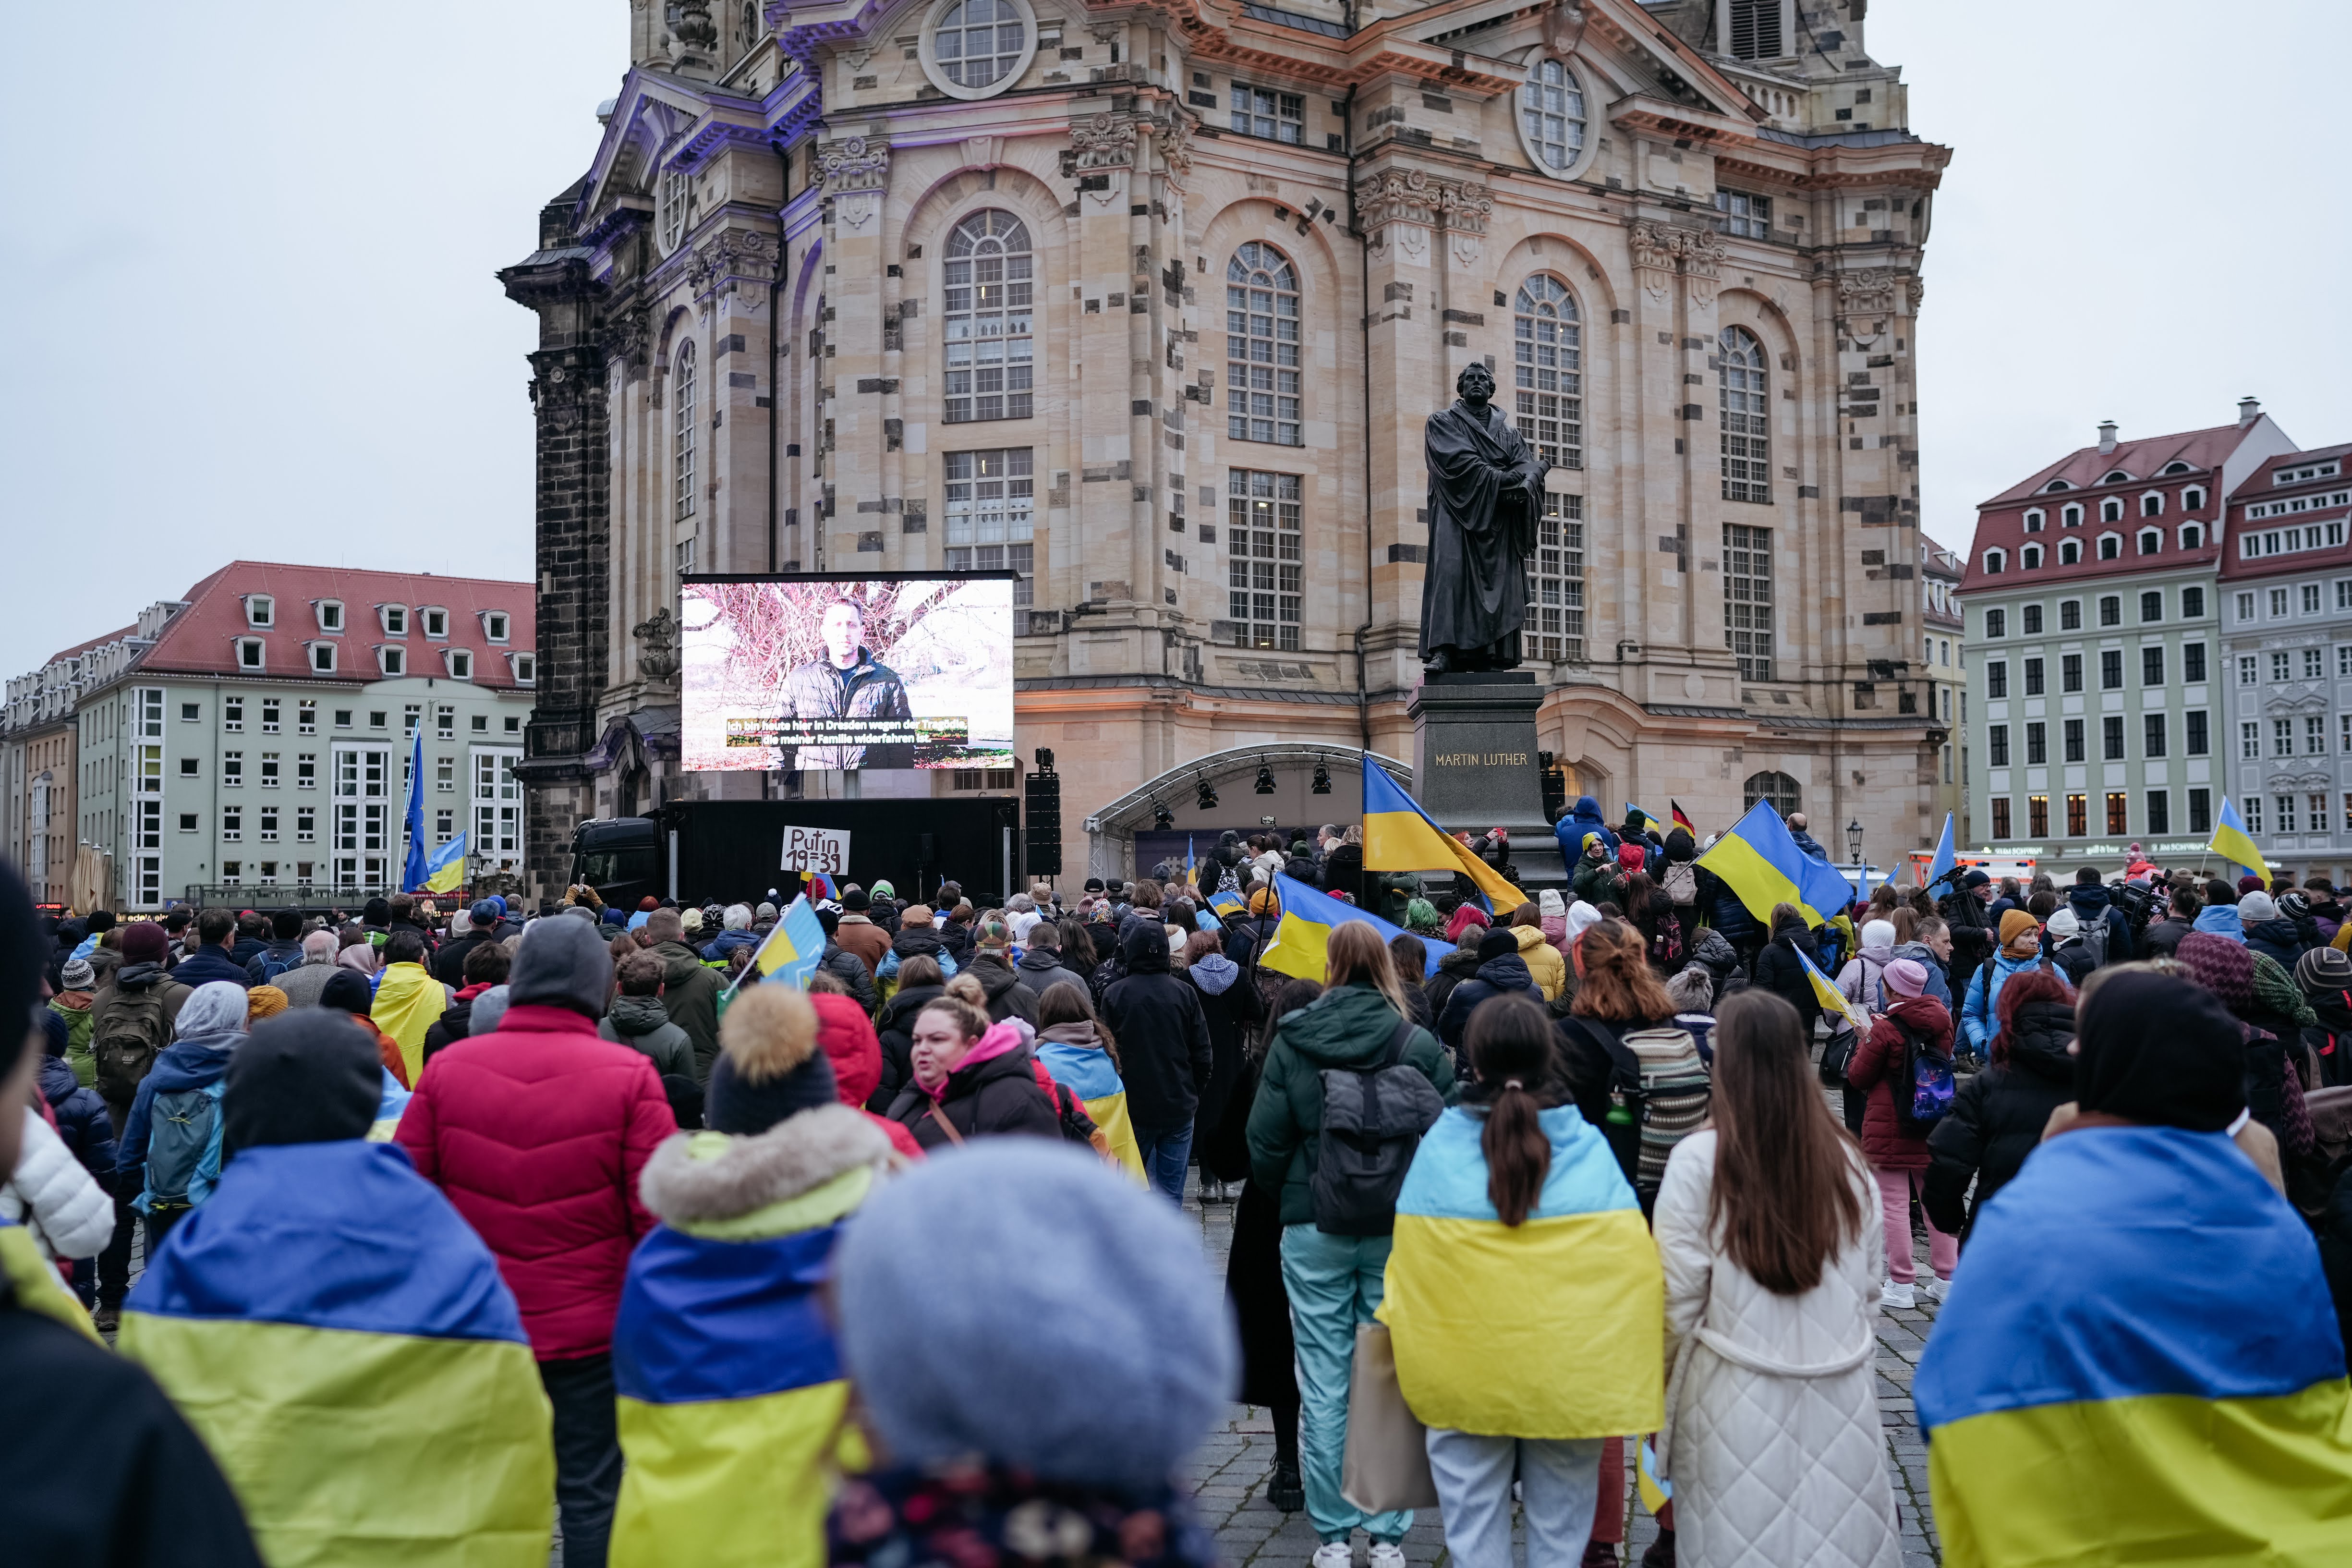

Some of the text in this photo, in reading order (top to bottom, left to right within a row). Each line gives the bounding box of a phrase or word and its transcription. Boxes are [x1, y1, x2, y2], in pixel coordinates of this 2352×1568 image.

[727, 720, 742, 731] Ich
[744, 720, 760, 731] bin
[762, 720, 791, 731] heute
[792, 720, 812, 730] hier
[814, 720, 824, 730] in
[826, 720, 867, 730] Dresden
[869, 721, 901, 732] wegen
[903, 719, 920, 729] der
[763, 733, 932, 744] die meiner Familie widerfahren ist.
[1436, 753, 1528, 766] MARTIN LUTHER
[790, 829, 839, 854] Putin
